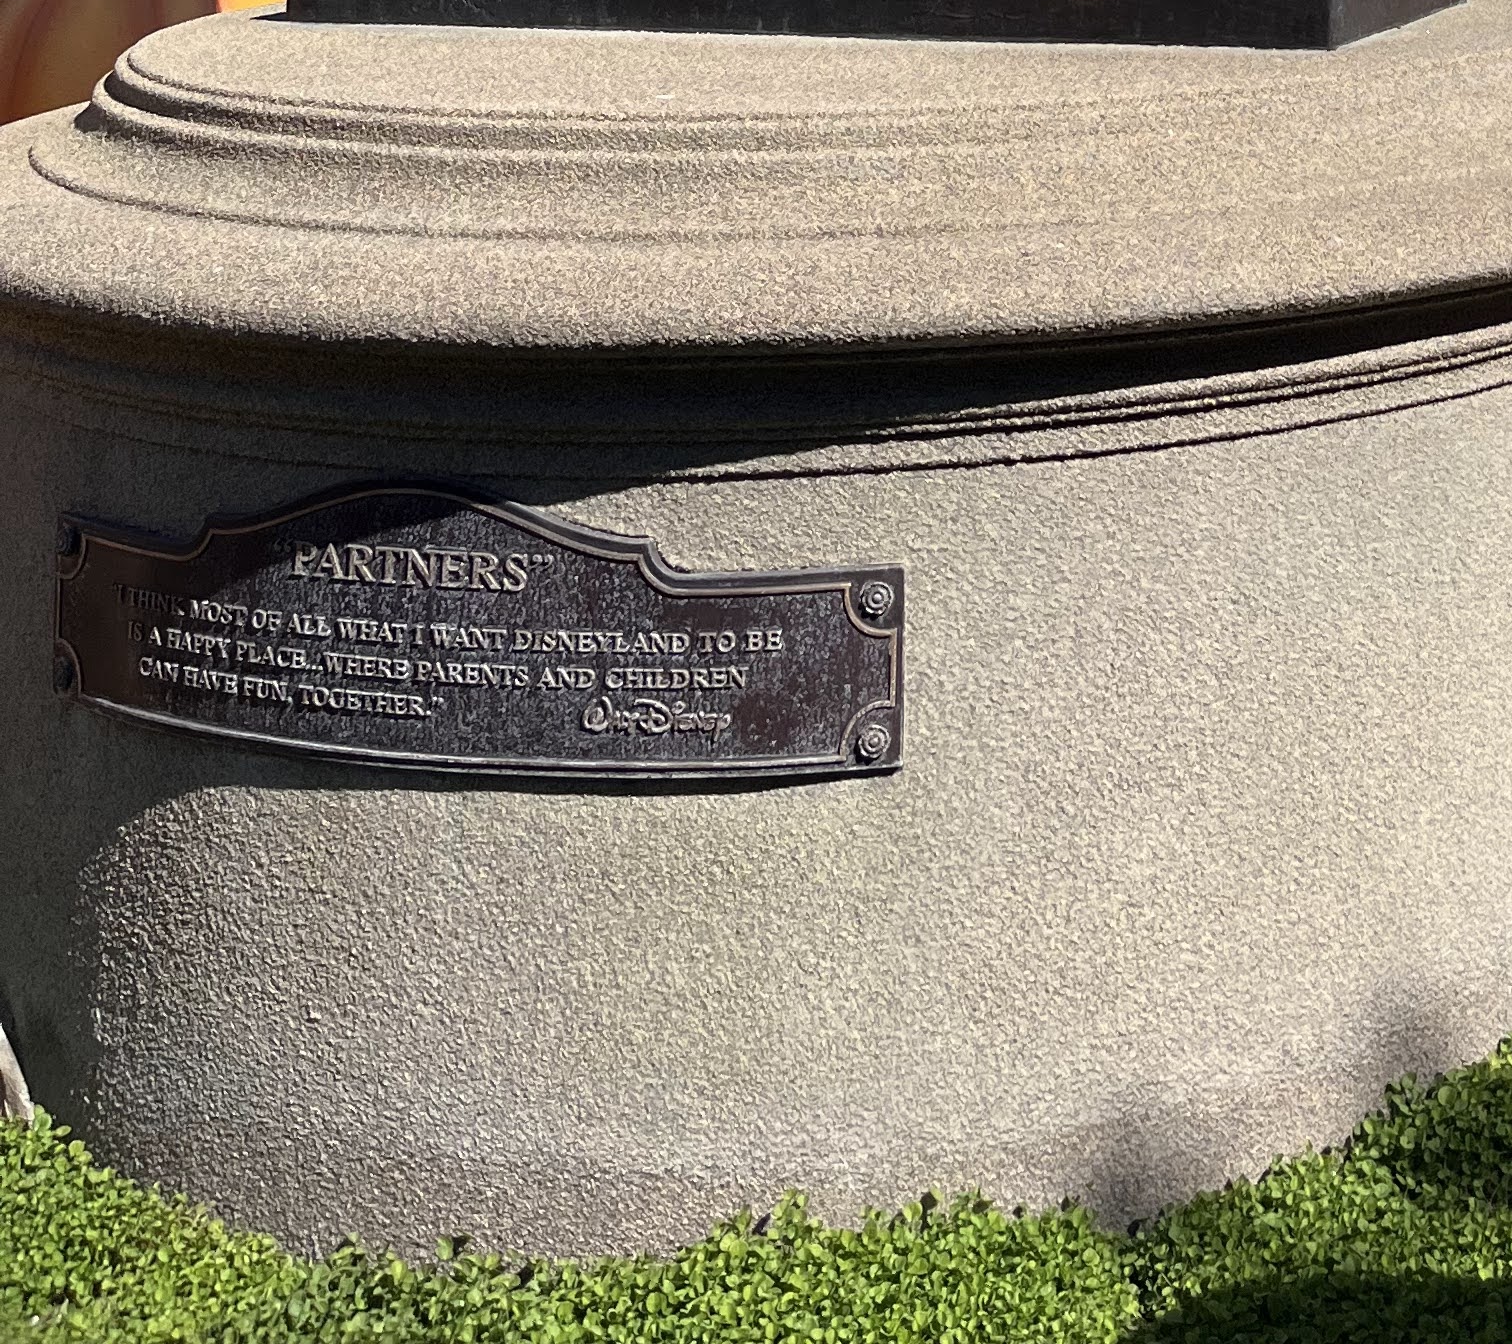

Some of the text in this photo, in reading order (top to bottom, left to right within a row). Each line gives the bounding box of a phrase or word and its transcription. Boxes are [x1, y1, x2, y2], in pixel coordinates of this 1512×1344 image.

[273, 541, 555, 592] “PARTNERS”
[129, 587, 185, 616] THINK
[190, 599, 248, 627] MOST
[252, 609, 283, 631] OF
[287, 613, 332, 636] ALL
[336, 617, 408, 645] WHAT
[412, 624, 425, 645] I
[429, 623, 508, 650] WANT
[512, 629, 690, 654] DISNEYLAND
[697, 631, 737, 653] TO
[744, 627, 785, 652] BE
[127, 621, 143, 642] IS
[148, 626, 162, 647] A
[166, 628, 232, 659] HAPPY
[415, 661, 529, 687] PARENTS
[536, 664, 597, 689] AND
[604, 666, 750, 689] CHILDREN
[139, 657, 180, 683] CAN
[183, 665, 239, 696] HAVE
[243, 676, 294, 707] FUN,
